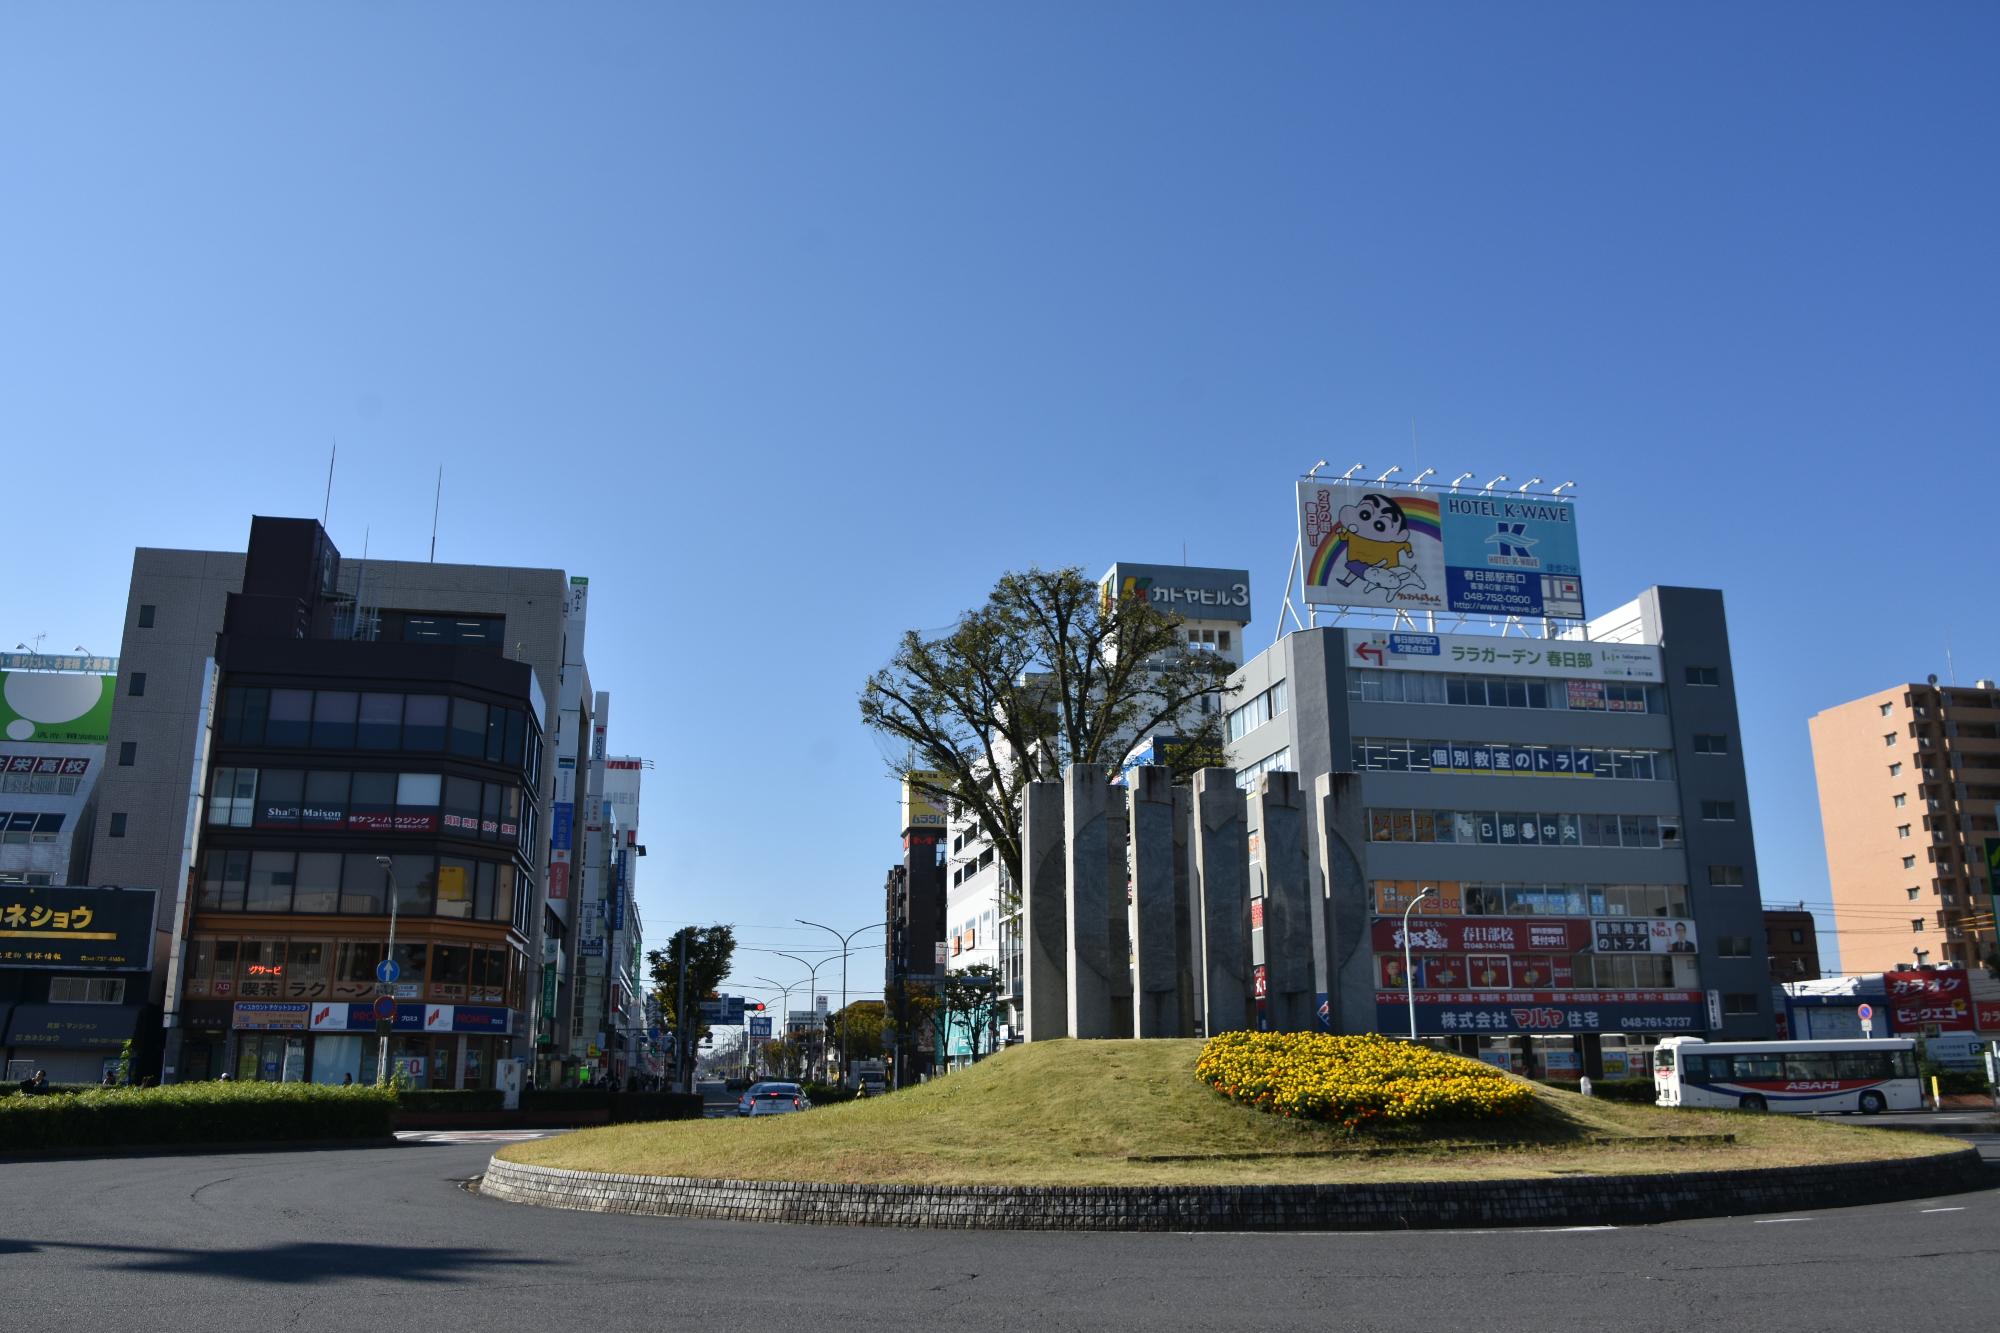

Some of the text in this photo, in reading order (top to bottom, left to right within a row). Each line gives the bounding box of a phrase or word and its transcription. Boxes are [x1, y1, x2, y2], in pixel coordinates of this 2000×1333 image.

[1449, 499, 1500, 517] HOTEL
[1464, 570, 1526, 584] 春日部駅西口
[1153, 583, 1249, 606] カドヤビル3
[1463, 592, 1531, 604] 048-752-0900
[1451, 645, 1593, 668] ララガーデン 春日部
[1432, 749, 1589, 771] 個別教室のトライ
[302, 809, 342, 818] Maison
[1463, 927, 1513, 942] 春日部校
[1598, 922, 1648, 935] 個別教室
[1651, 927, 1672, 938] No.1
[1599, 937, 1648, 950] のトライ
[216, 982, 231, 991] 入口
[241, 982, 279, 997] 喫茶
[1892, 977, 1961, 993] カラオケ
[1440, 1007, 1600, 1029] 株式会社 マルヤ 住宅
[1897, 1006, 1968, 1022] ビッグエコー
[1620, 1016, 1692, 1028] 048-761-3737
